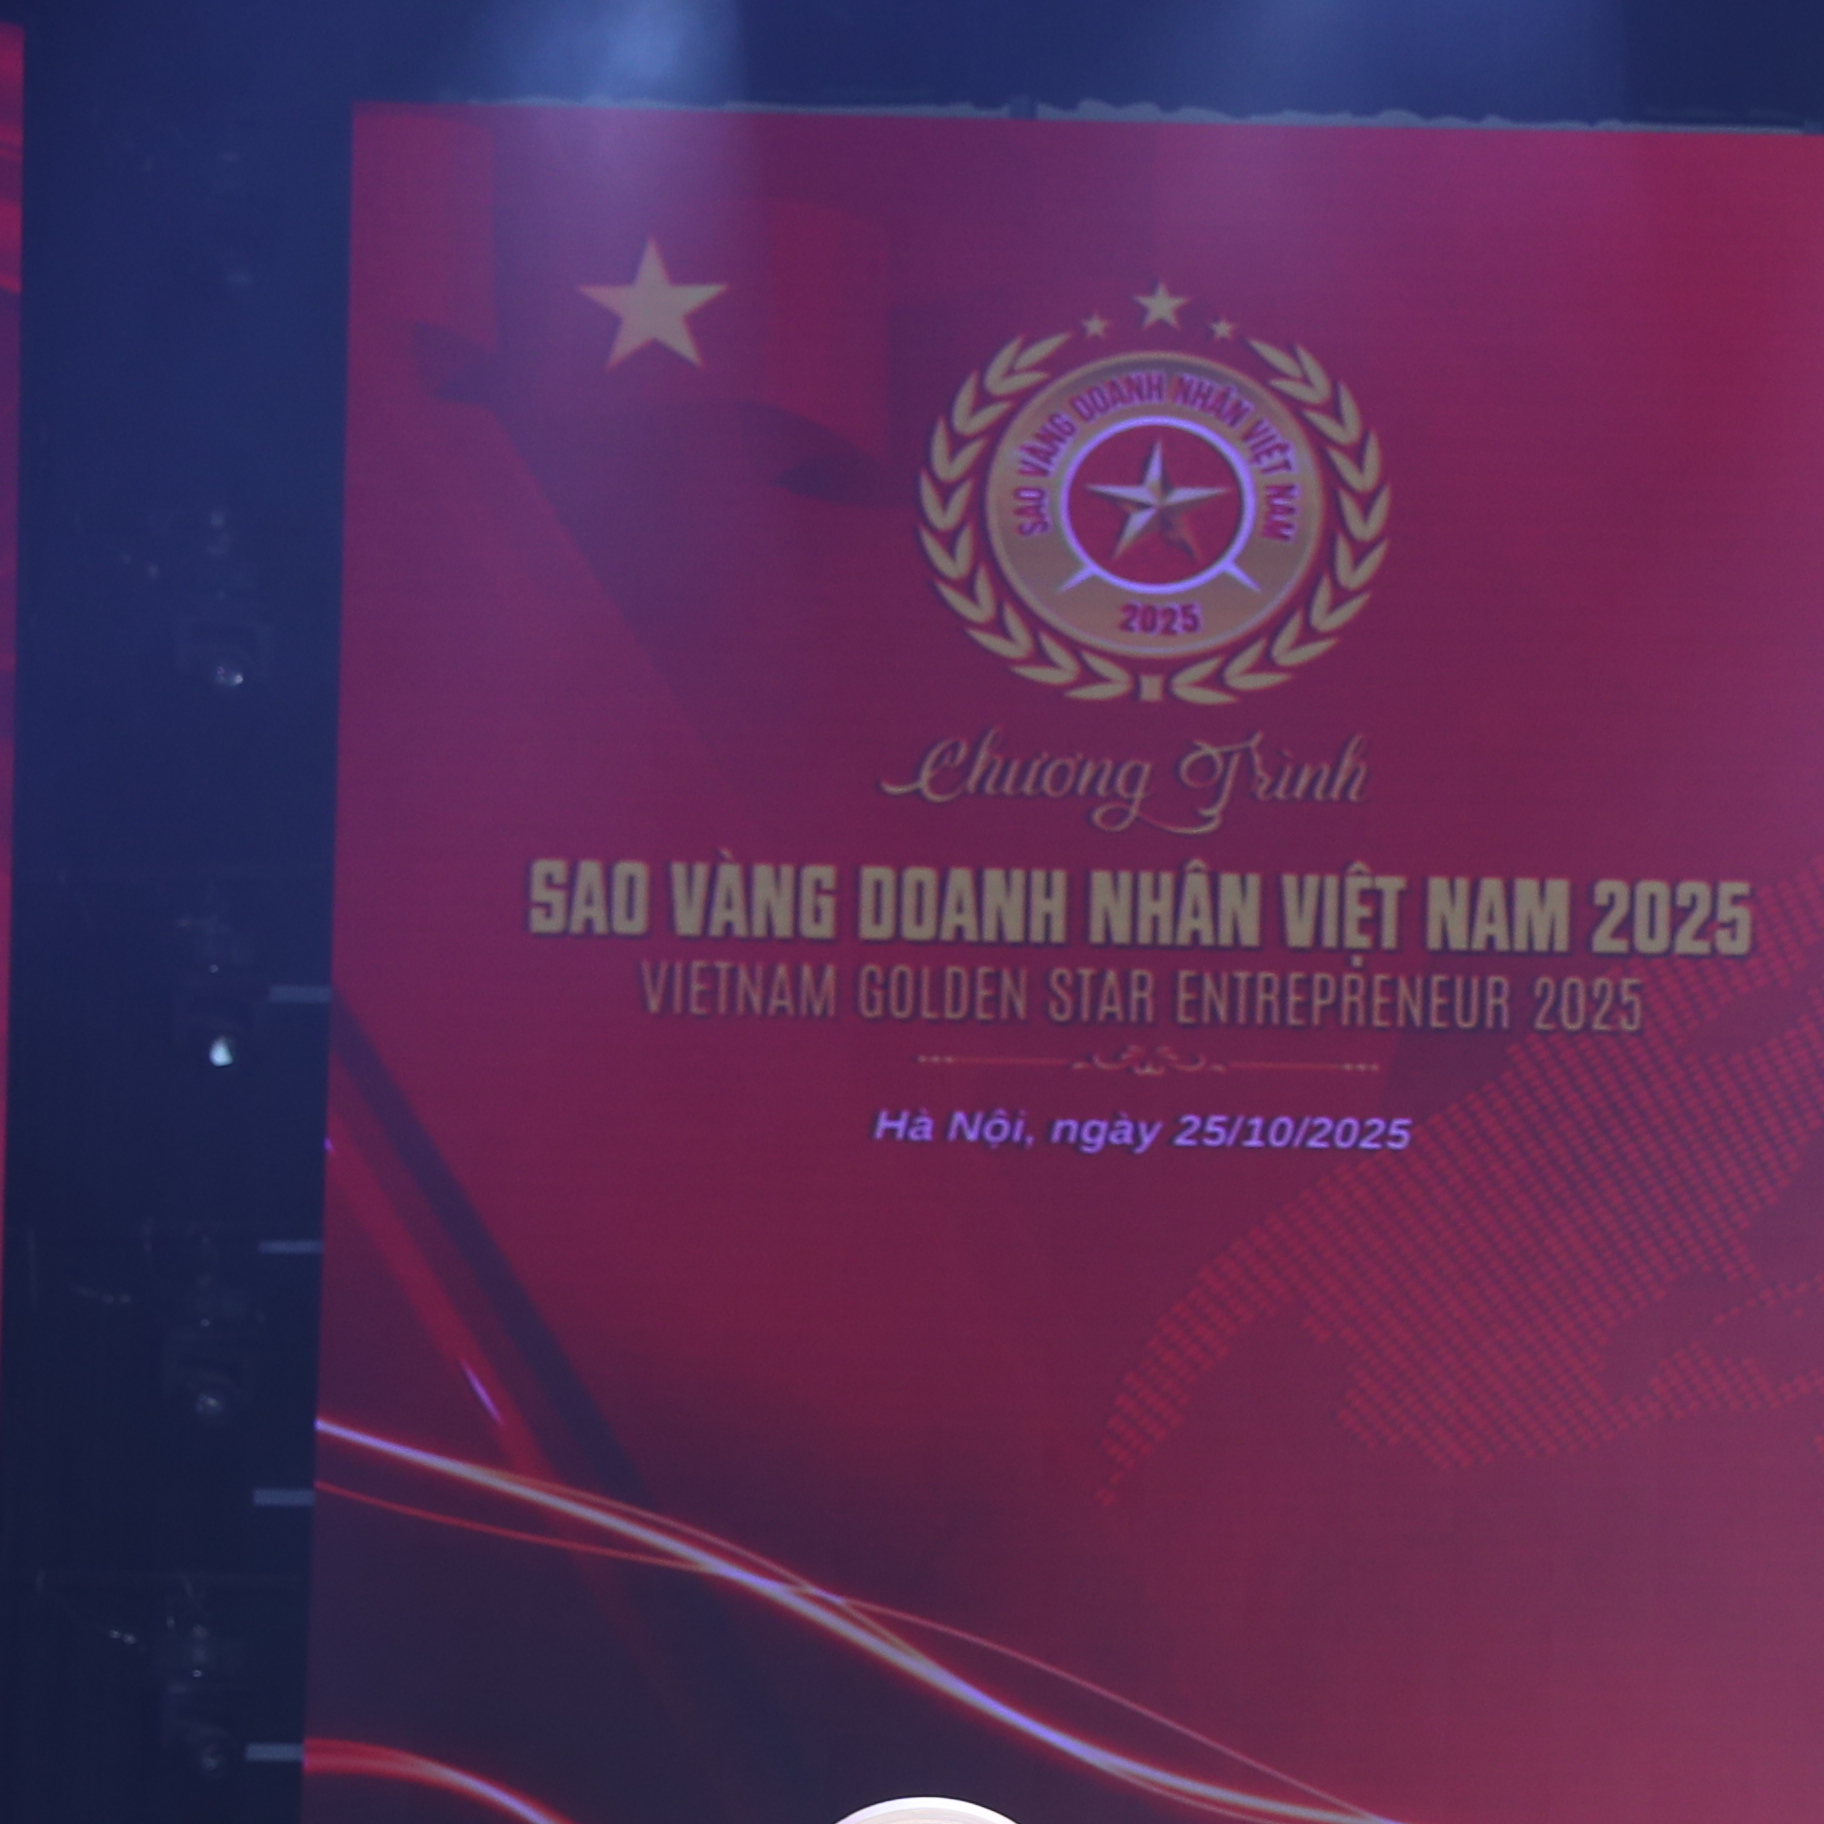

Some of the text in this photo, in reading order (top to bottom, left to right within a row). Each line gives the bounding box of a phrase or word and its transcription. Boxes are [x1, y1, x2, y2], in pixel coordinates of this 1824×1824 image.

[1013, 487, 1049, 537] SAO
[1071, 370, 1167, 423] DOANH
[1262, 483, 1298, 542] NAM
[1120, 602, 1203, 634] 2025
[881, 727, 1368, 834] Chương Trình
[529, 848, 1751, 967] SAO VÀNG DOANH NHÂN VIỆT NAM 2025
[641, 960, 1642, 1031] VIETNAM GOLDEN STAR ENTREPRENEUR 2025
[873, 1110, 1413, 1153] Hà Nội, ngày 25/10/2025
